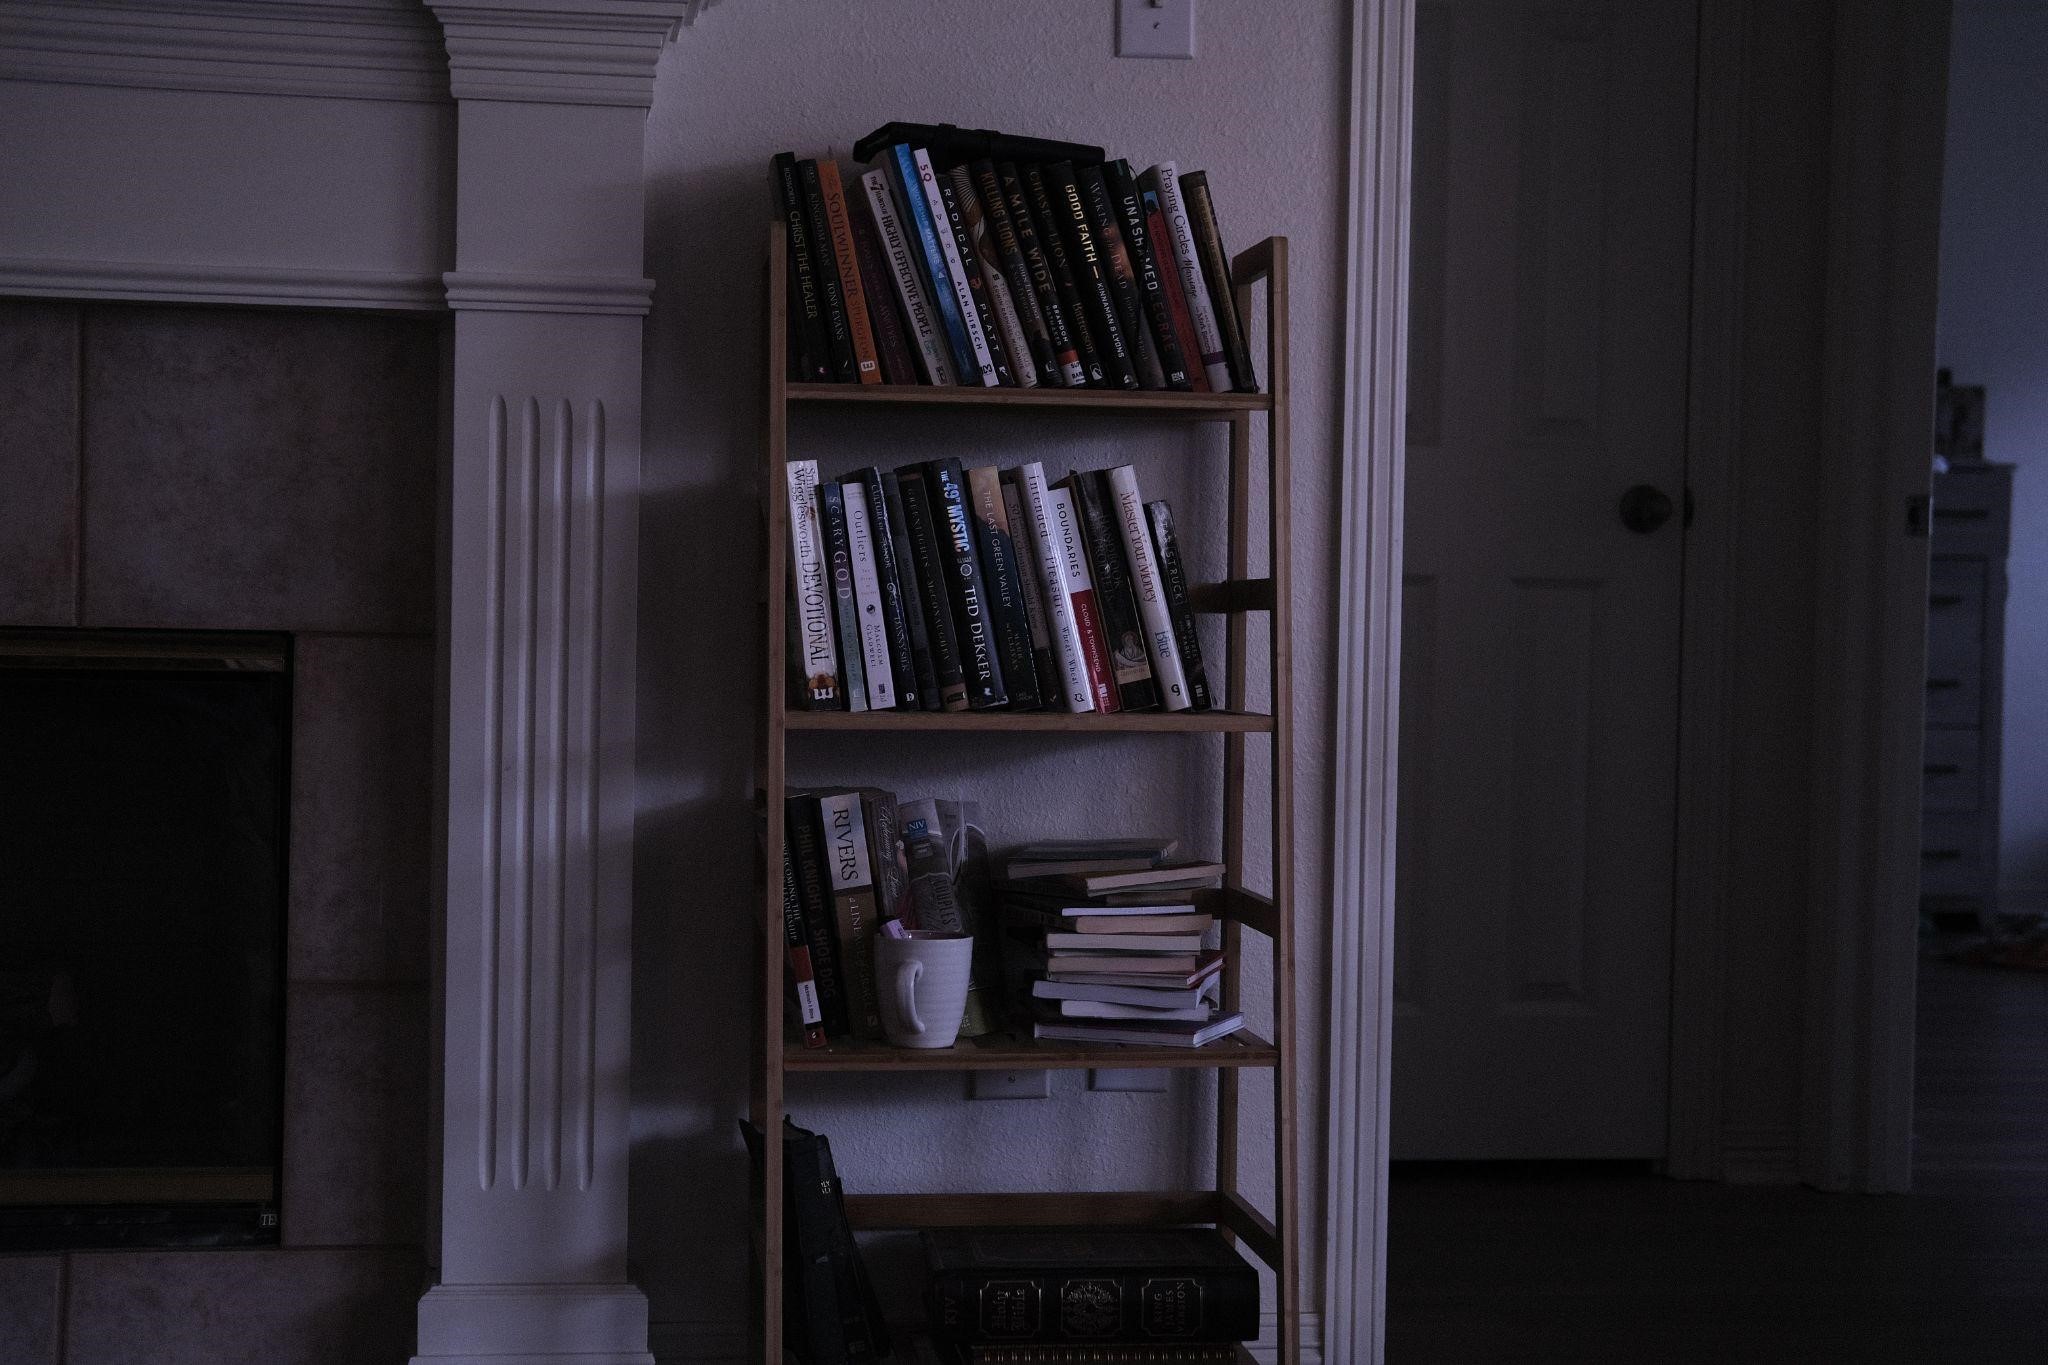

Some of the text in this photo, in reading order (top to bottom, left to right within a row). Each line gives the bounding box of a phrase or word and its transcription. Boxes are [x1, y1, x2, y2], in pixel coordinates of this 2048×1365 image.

[826, 191, 860, 298] SOULWINNER
[941, 186, 974, 267] RADICAL
[978, 169, 1019, 256] KILLING LIONS
[1002, 173, 1052, 295] A MILE WIDE
[1063, 182, 1097, 264] GOOD FAITH
[1158, 167, 1182, 213] Praying
[1172, 214, 1193, 255] Circles
[787, 208, 818, 319] CHRIST THE HEALER
[880, 213, 902, 250] HIGHLY
[892, 248, 920, 302] EFFECTIVE
[910, 299, 932, 338] PEOPLE
[825, 280, 845, 341] TONY EVANS
[955, 279, 983, 351] ALAN HIRSCH
[977, 302, 1000, 353] PLATT
[1050, 303, 1069, 343] BRANDON
[1095, 281, 1114, 325] KINNAMAN
[1110, 331, 1125, 359] LYONS
[828, 494, 850, 600] SCARY GOD
[851, 509, 870, 562] Outliers
[939, 469, 950, 482] THE
[945, 503, 971, 554] MYSTIC
[982, 489, 1012, 609] THE LAST GREEN VALLEY
[1054, 502, 1082, 578] BOUNDARIES
[790, 467, 830, 666] Wigglesworth DEVOTIONAL
[1042, 555, 1069, 618] Pleasure
[1119, 490, 1171, 659] Master Your Money Blue
[1163, 549, 1185, 600] STRUCK
[872, 623, 885, 666] MALCOLM
[961, 584, 993, 680] TED DEKKER
[1079, 602, 1091, 627] CLOUD
[1086, 634, 1102, 673] TOWNSEND
[796, 823, 824, 914] PHIL KNIGHT
[831, 807, 858, 881] RIVERS
[811, 927, 830, 965] SHOE
